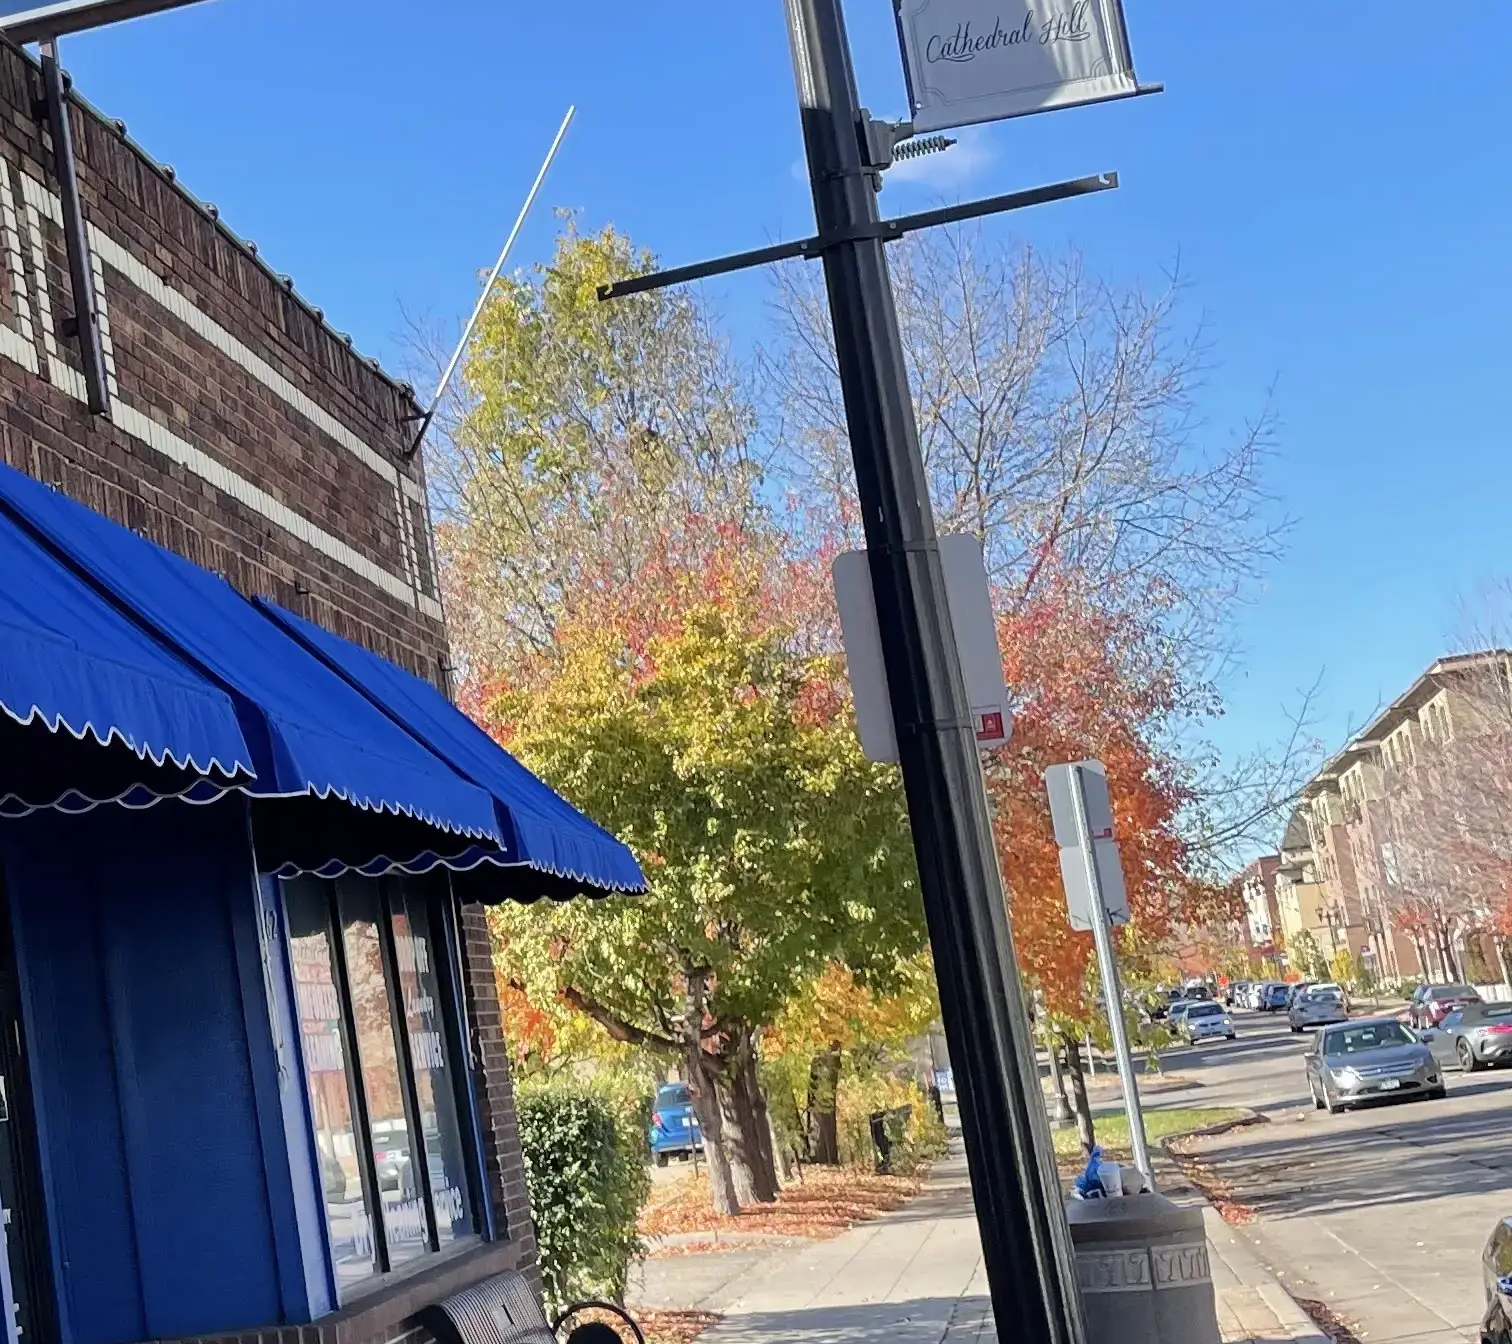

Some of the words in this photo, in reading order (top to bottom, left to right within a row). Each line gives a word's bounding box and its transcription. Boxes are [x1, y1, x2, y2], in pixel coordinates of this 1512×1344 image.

[926, 8, 1034, 64] Cathedral
[1038, 0, 1091, 45] Hill
[432, 1175, 464, 1223] ervice
